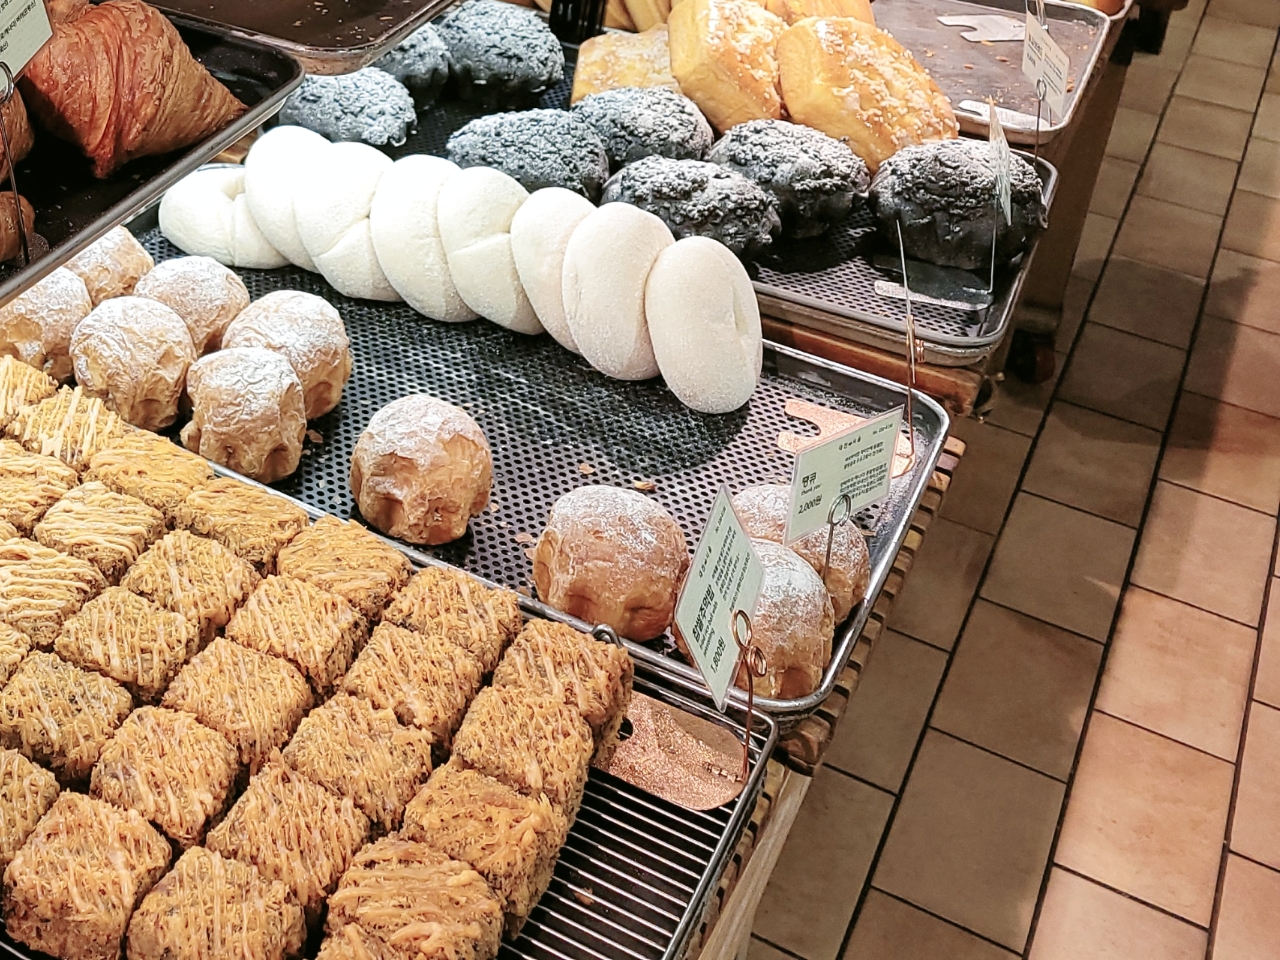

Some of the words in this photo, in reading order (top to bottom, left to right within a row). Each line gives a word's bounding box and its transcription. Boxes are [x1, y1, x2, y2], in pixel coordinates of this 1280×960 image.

[798, 494, 822, 514] 2,000원
[692, 584, 714, 643] 찹쌀주먹밥
[710, 635, 726, 674] 1,800원
